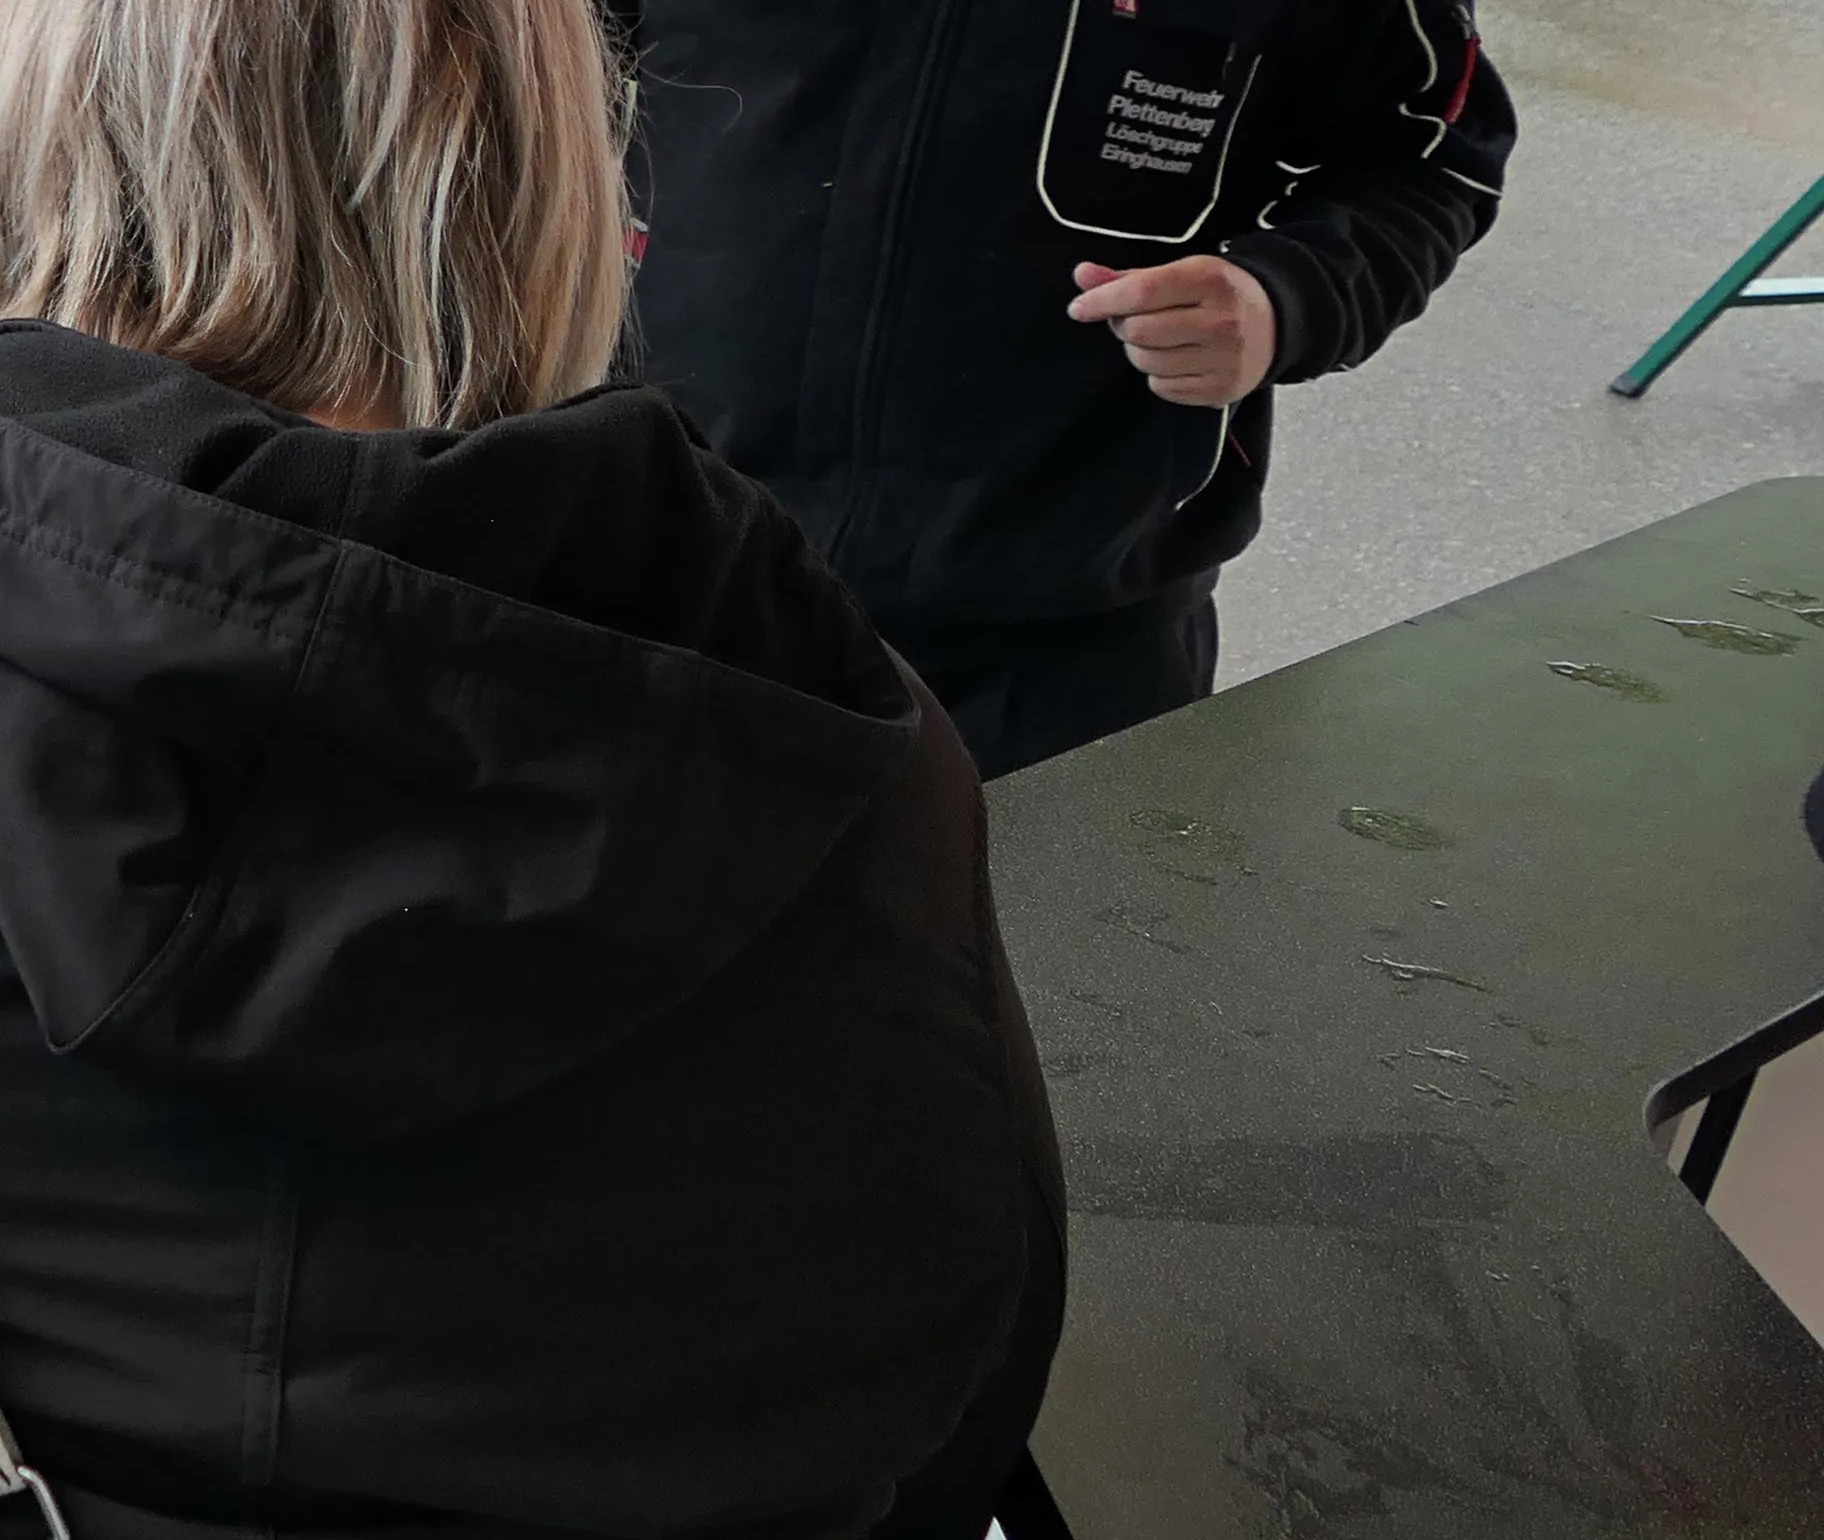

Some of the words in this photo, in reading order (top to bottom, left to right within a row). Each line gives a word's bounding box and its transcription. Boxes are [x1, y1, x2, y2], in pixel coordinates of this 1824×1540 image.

[1122, 70, 1225, 108] Feuerwehr
[1107, 94, 1216, 138] Plettenberg
[1105, 122, 1203, 156] Löschgruppe
